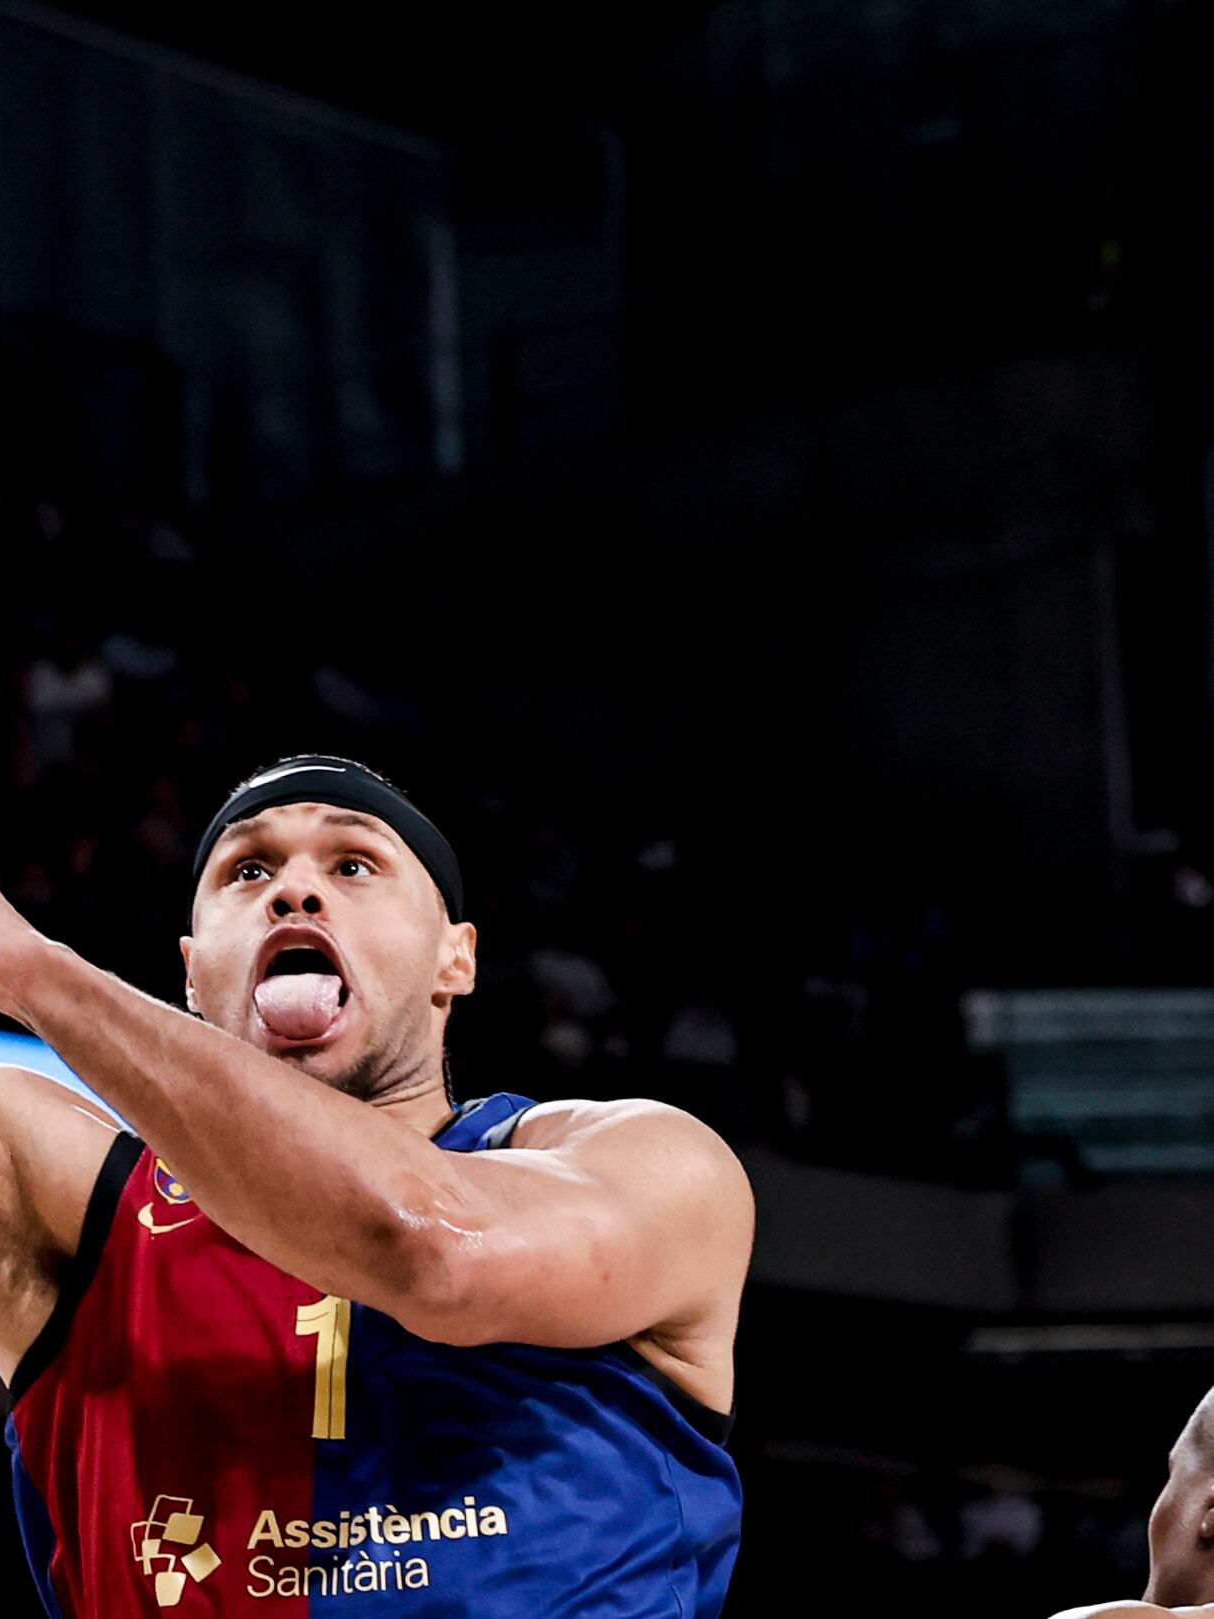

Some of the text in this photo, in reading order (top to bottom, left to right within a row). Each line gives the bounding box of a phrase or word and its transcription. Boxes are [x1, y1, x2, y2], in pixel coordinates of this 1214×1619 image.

[295, 1294, 352, 1440] 1
[247, 1496, 508, 1550] Assistència
[246, 1551, 430, 1598] Sanitària
